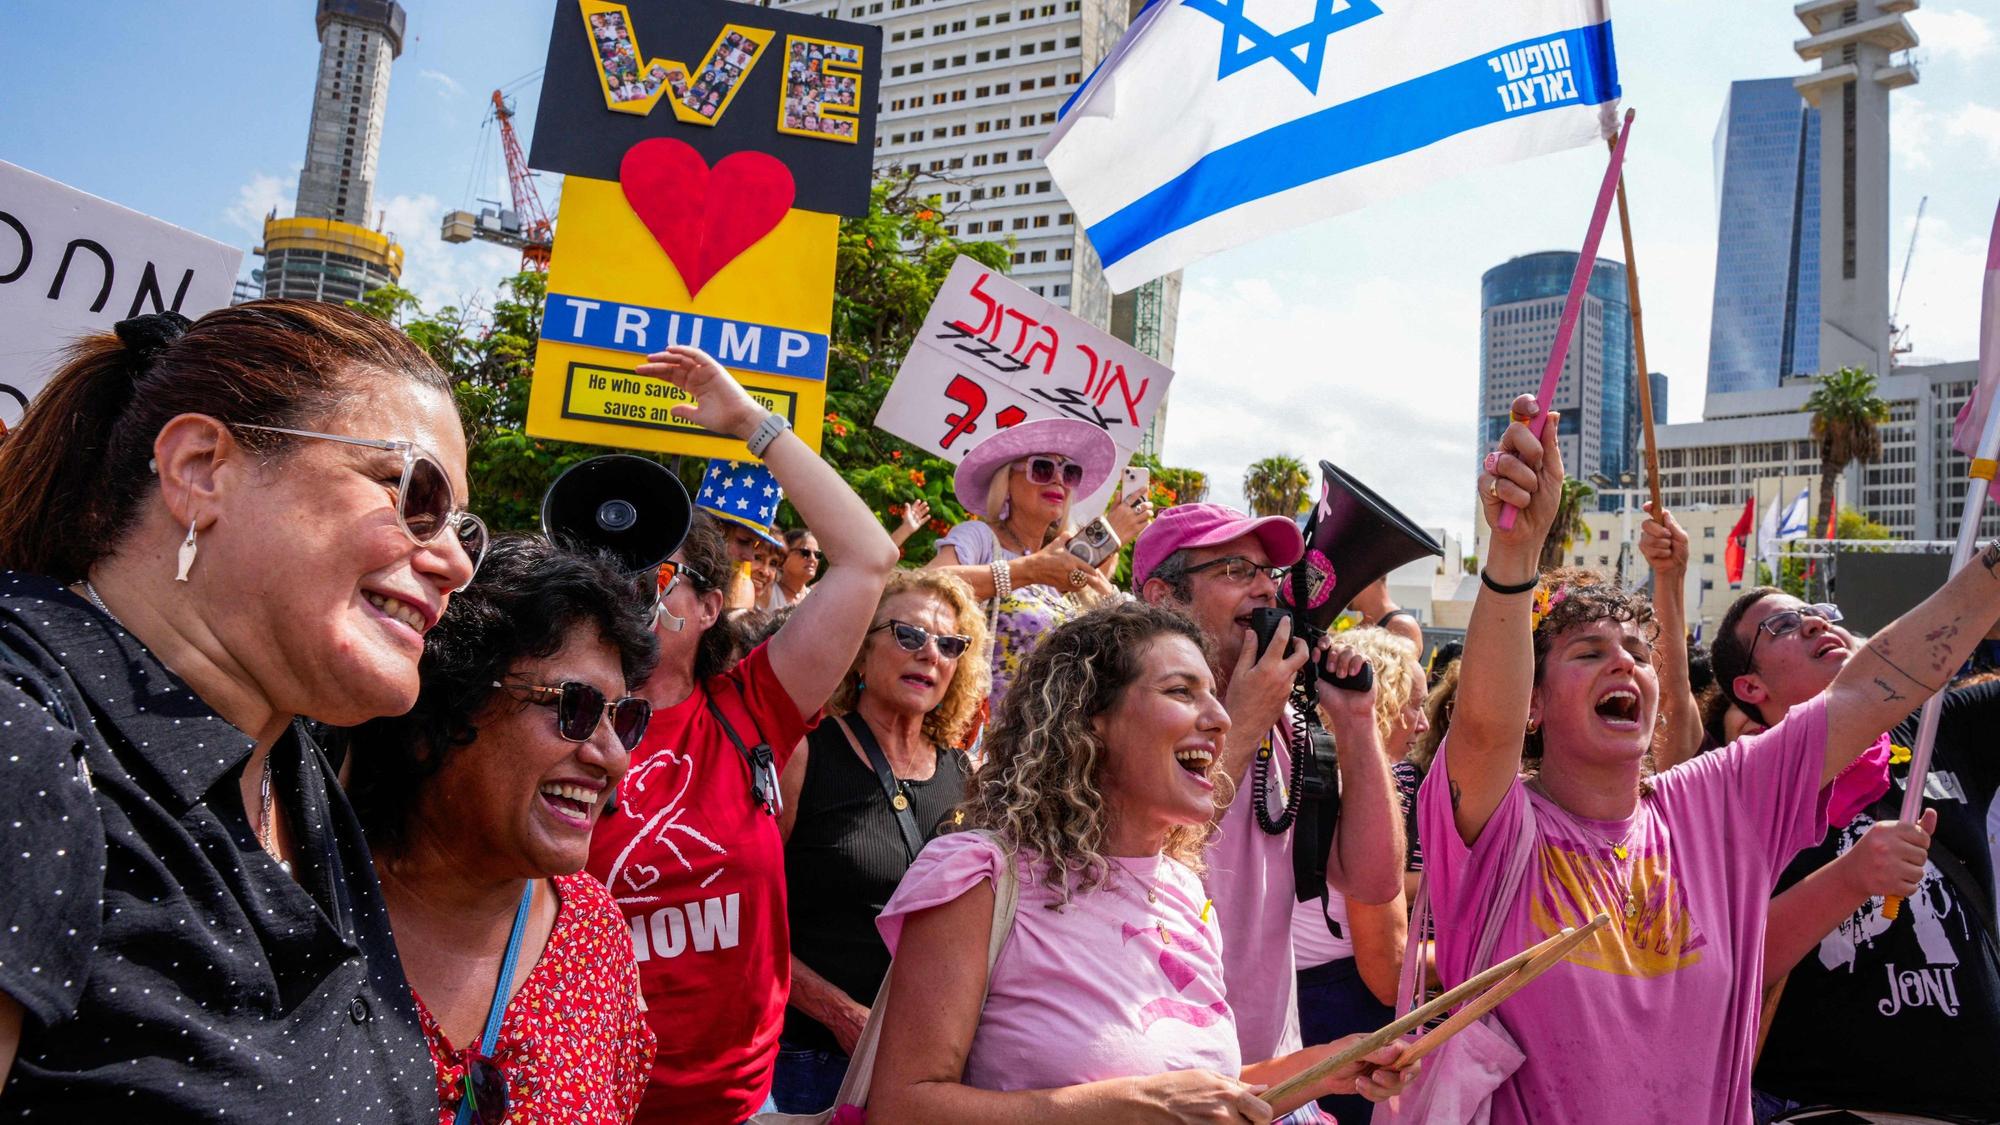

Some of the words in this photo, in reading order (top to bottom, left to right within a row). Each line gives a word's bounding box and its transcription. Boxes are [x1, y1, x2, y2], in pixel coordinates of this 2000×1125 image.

[578, 0, 864, 144] WE
[1487, 38, 1571, 81] חופשי
[1497, 69, 1579, 113] בארצנו
[565, 298, 811, 368] TRUMP
[952, 273, 1059, 375] גדול
[588, 374, 607, 390] He
[611, 378, 641, 394] who
[645, 383, 687, 400] saves
[603, 401, 646, 419] saves
[650, 407, 668, 421] an
[1076, 344, 1149, 428] אור
[1878, 963, 1961, 1016] JONI
